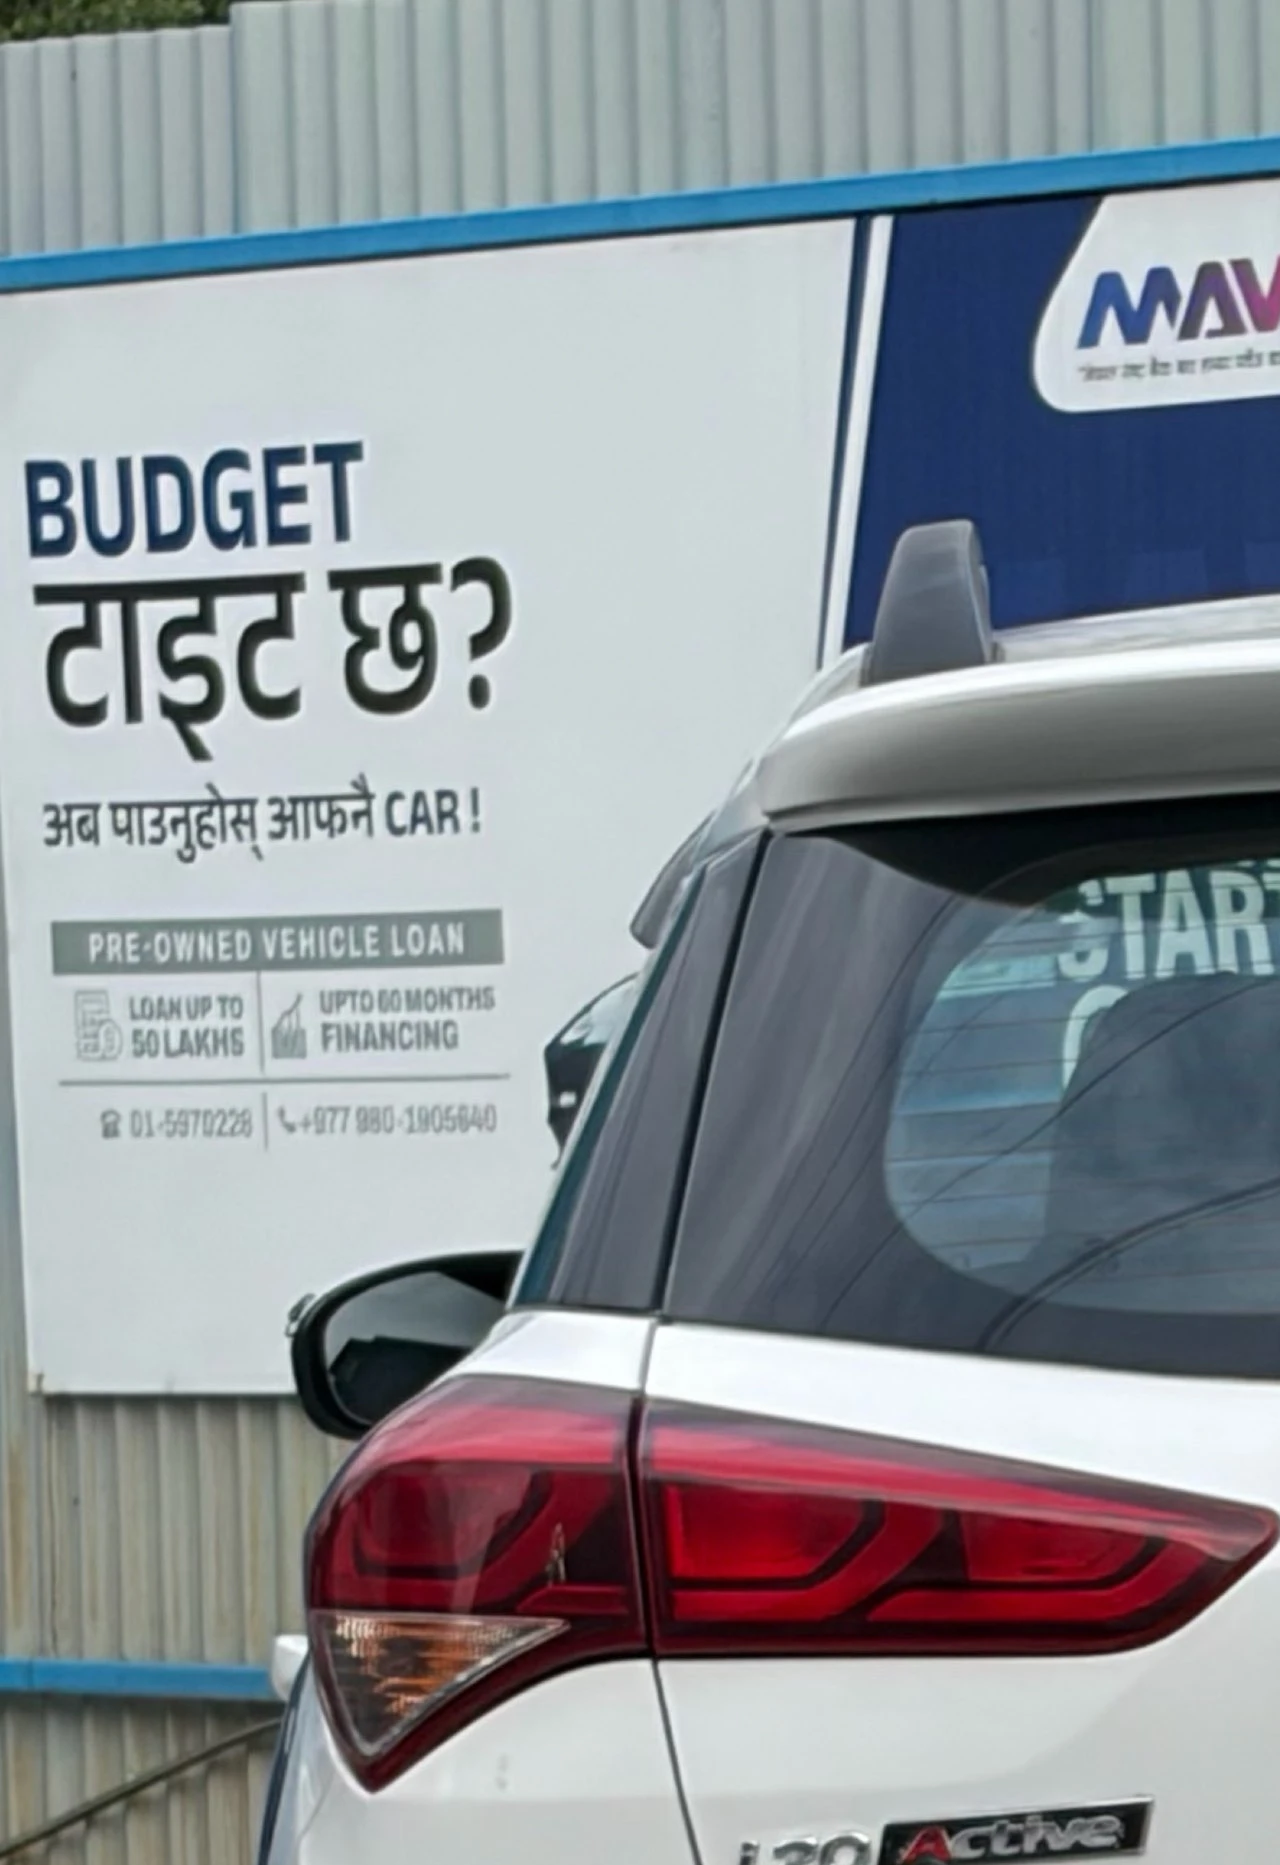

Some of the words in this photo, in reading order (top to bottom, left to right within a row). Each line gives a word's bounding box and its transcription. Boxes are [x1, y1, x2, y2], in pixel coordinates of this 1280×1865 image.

[24, 440, 364, 558] BUDGET
[33, 571, 306, 762] टाइट
[327, 556, 513, 715] छ?
[43, 802, 101, 847] अब
[109, 782, 264, 865] पाउनुहोस्
[89, 928, 253, 965] PRE-OWNED
[261, 924, 380, 961] VEHICLE
[391, 921, 466, 957] LOAN
[129, 995, 182, 1021] LOAN
[186, 995, 212, 1020] UP
[216, 994, 243, 1019] TO
[404, 985, 496, 1013] MONTHS
[132, 1027, 160, 1059] 50
[164, 1026, 245, 1059] LAKHS
[320, 1018, 459, 1053] FINANCING
